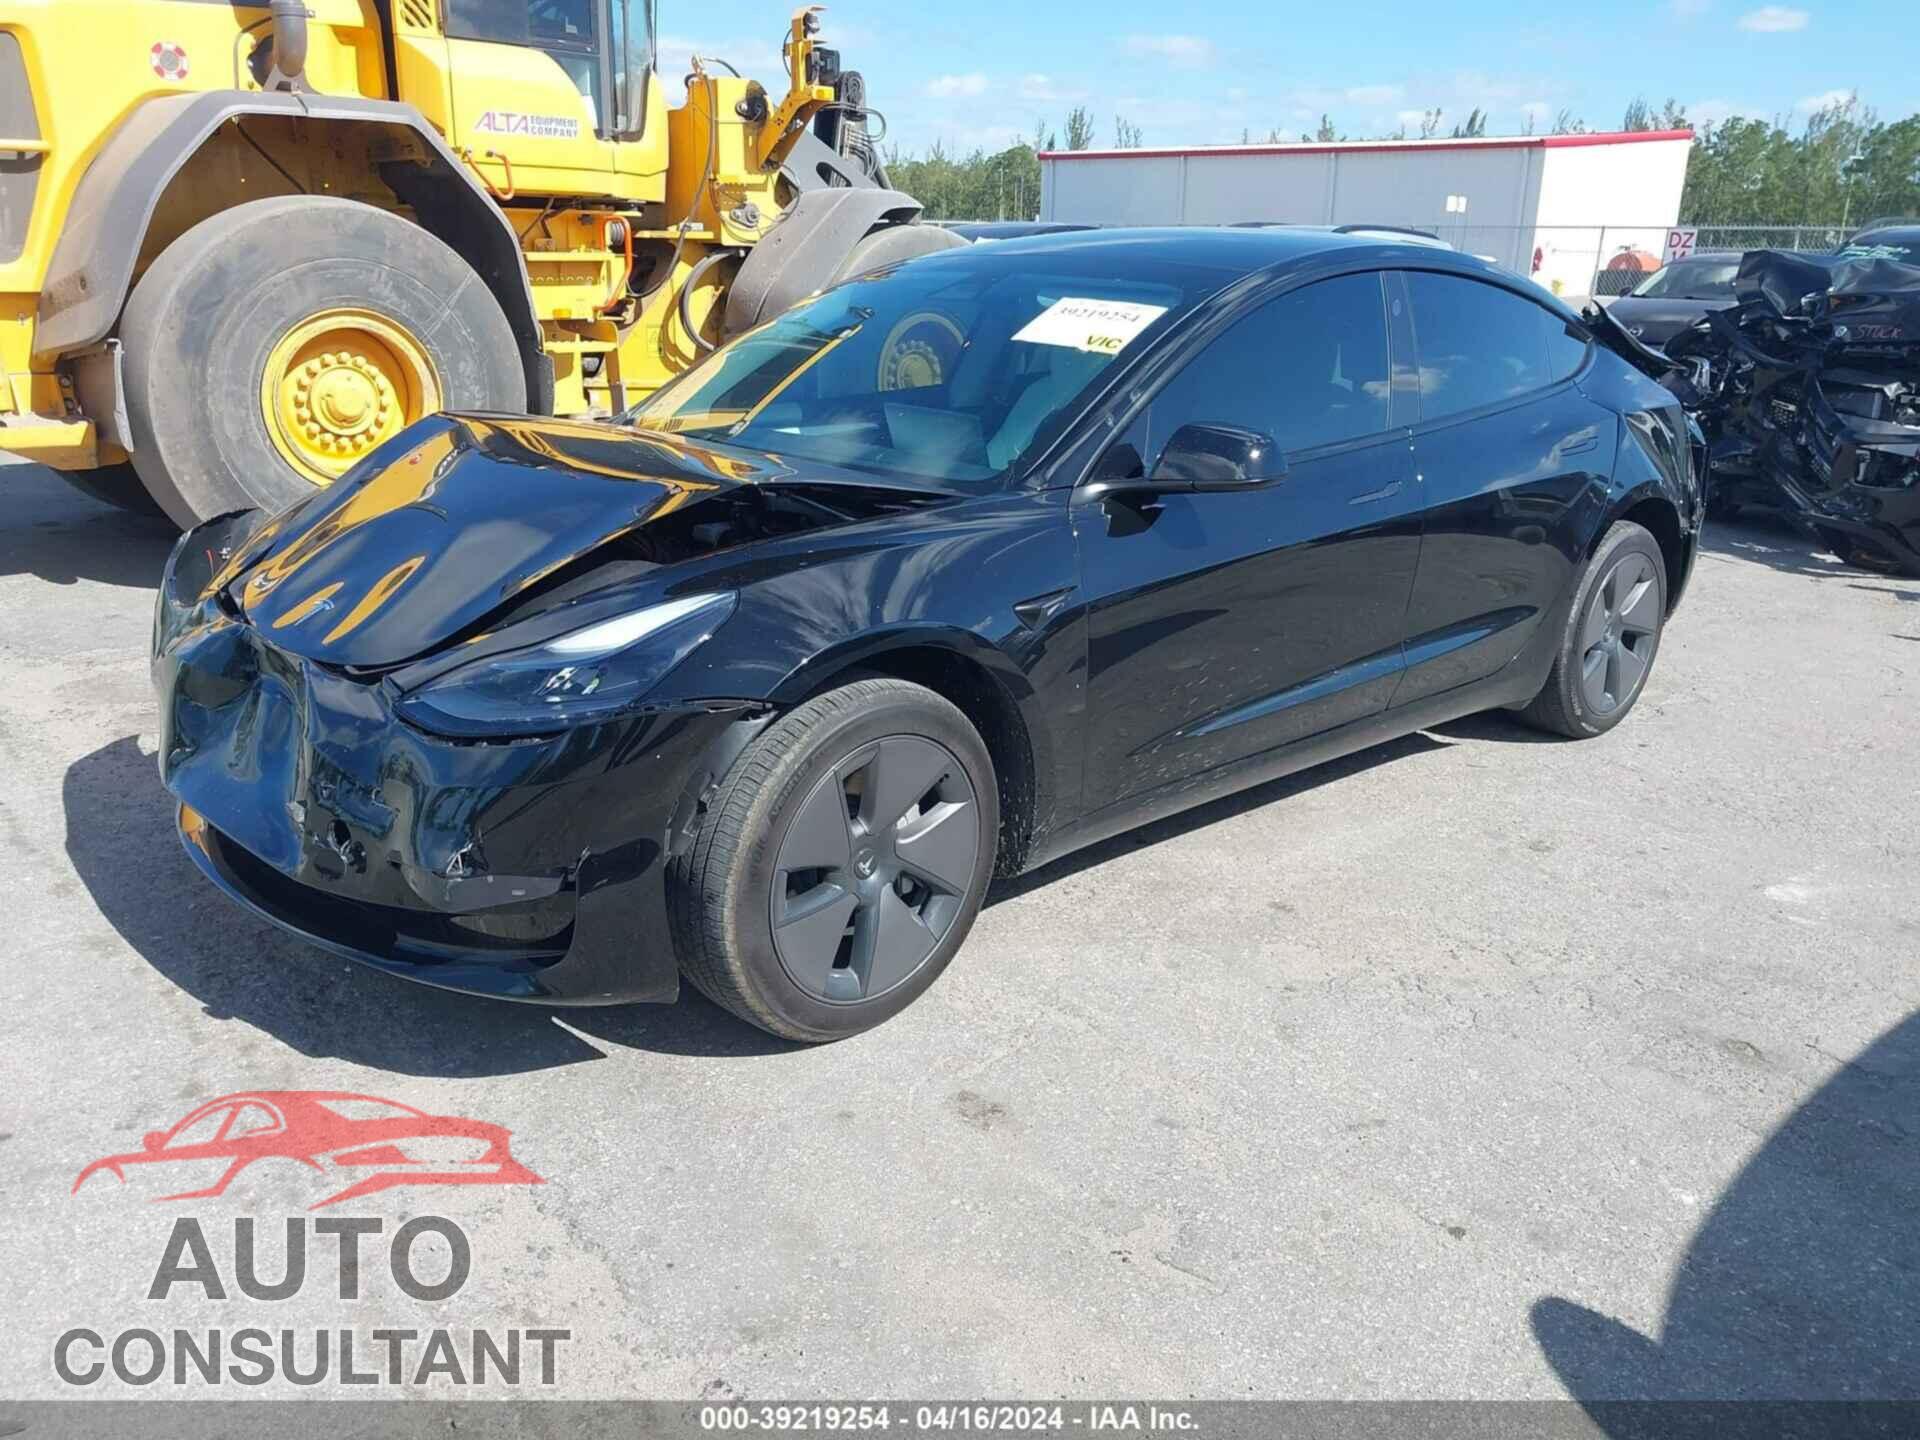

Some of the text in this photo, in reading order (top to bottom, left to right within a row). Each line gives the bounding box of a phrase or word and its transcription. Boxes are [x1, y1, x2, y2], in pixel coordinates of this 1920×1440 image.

[474, 111, 529, 134] ALTA
[530, 115, 578, 128] EQUIPMENT
[530, 126, 578, 138] COMPANY
[1669, 231, 1695, 248] DZ
[1087, 335, 1123, 349] VIC
